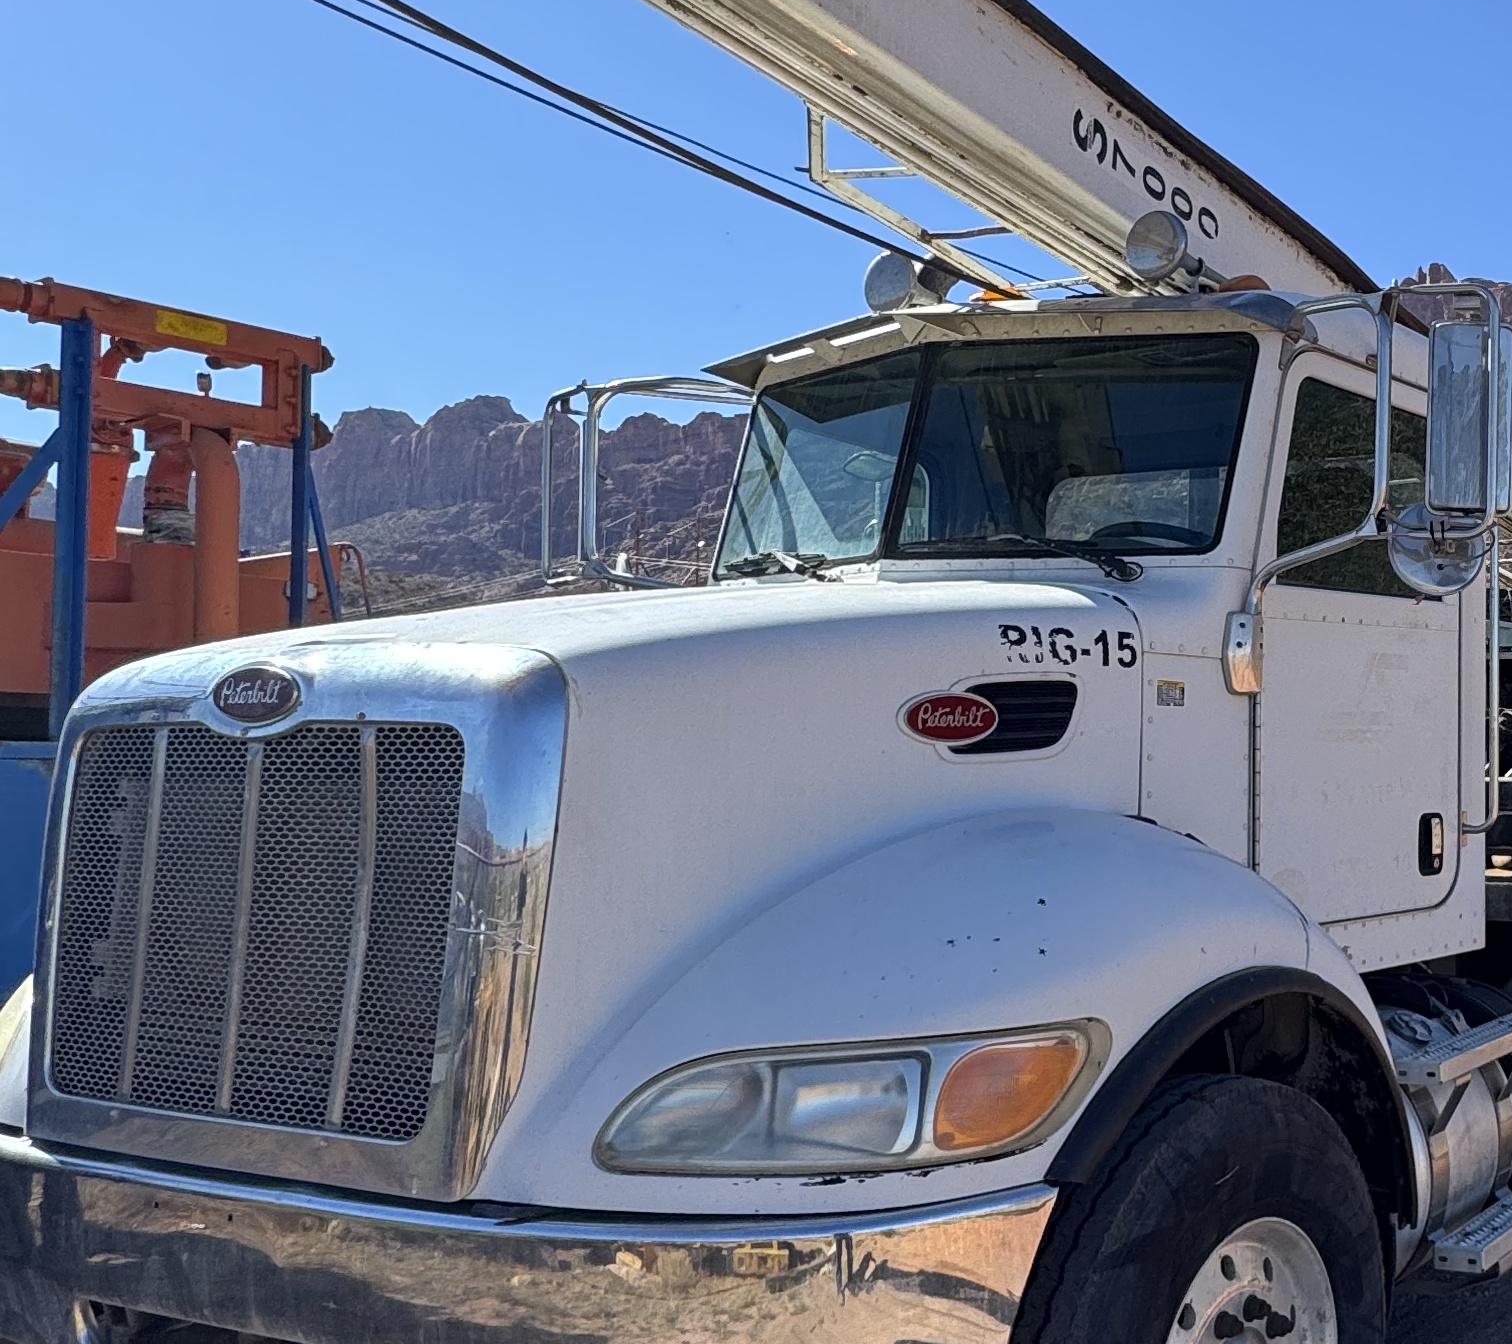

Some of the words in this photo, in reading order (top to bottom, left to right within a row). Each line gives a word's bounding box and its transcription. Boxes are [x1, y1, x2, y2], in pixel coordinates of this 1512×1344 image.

[998, 624, 1137, 669] RIG-15
[219, 677, 286, 707] Peterbilt
[917, 703, 990, 730] Peterbilt
